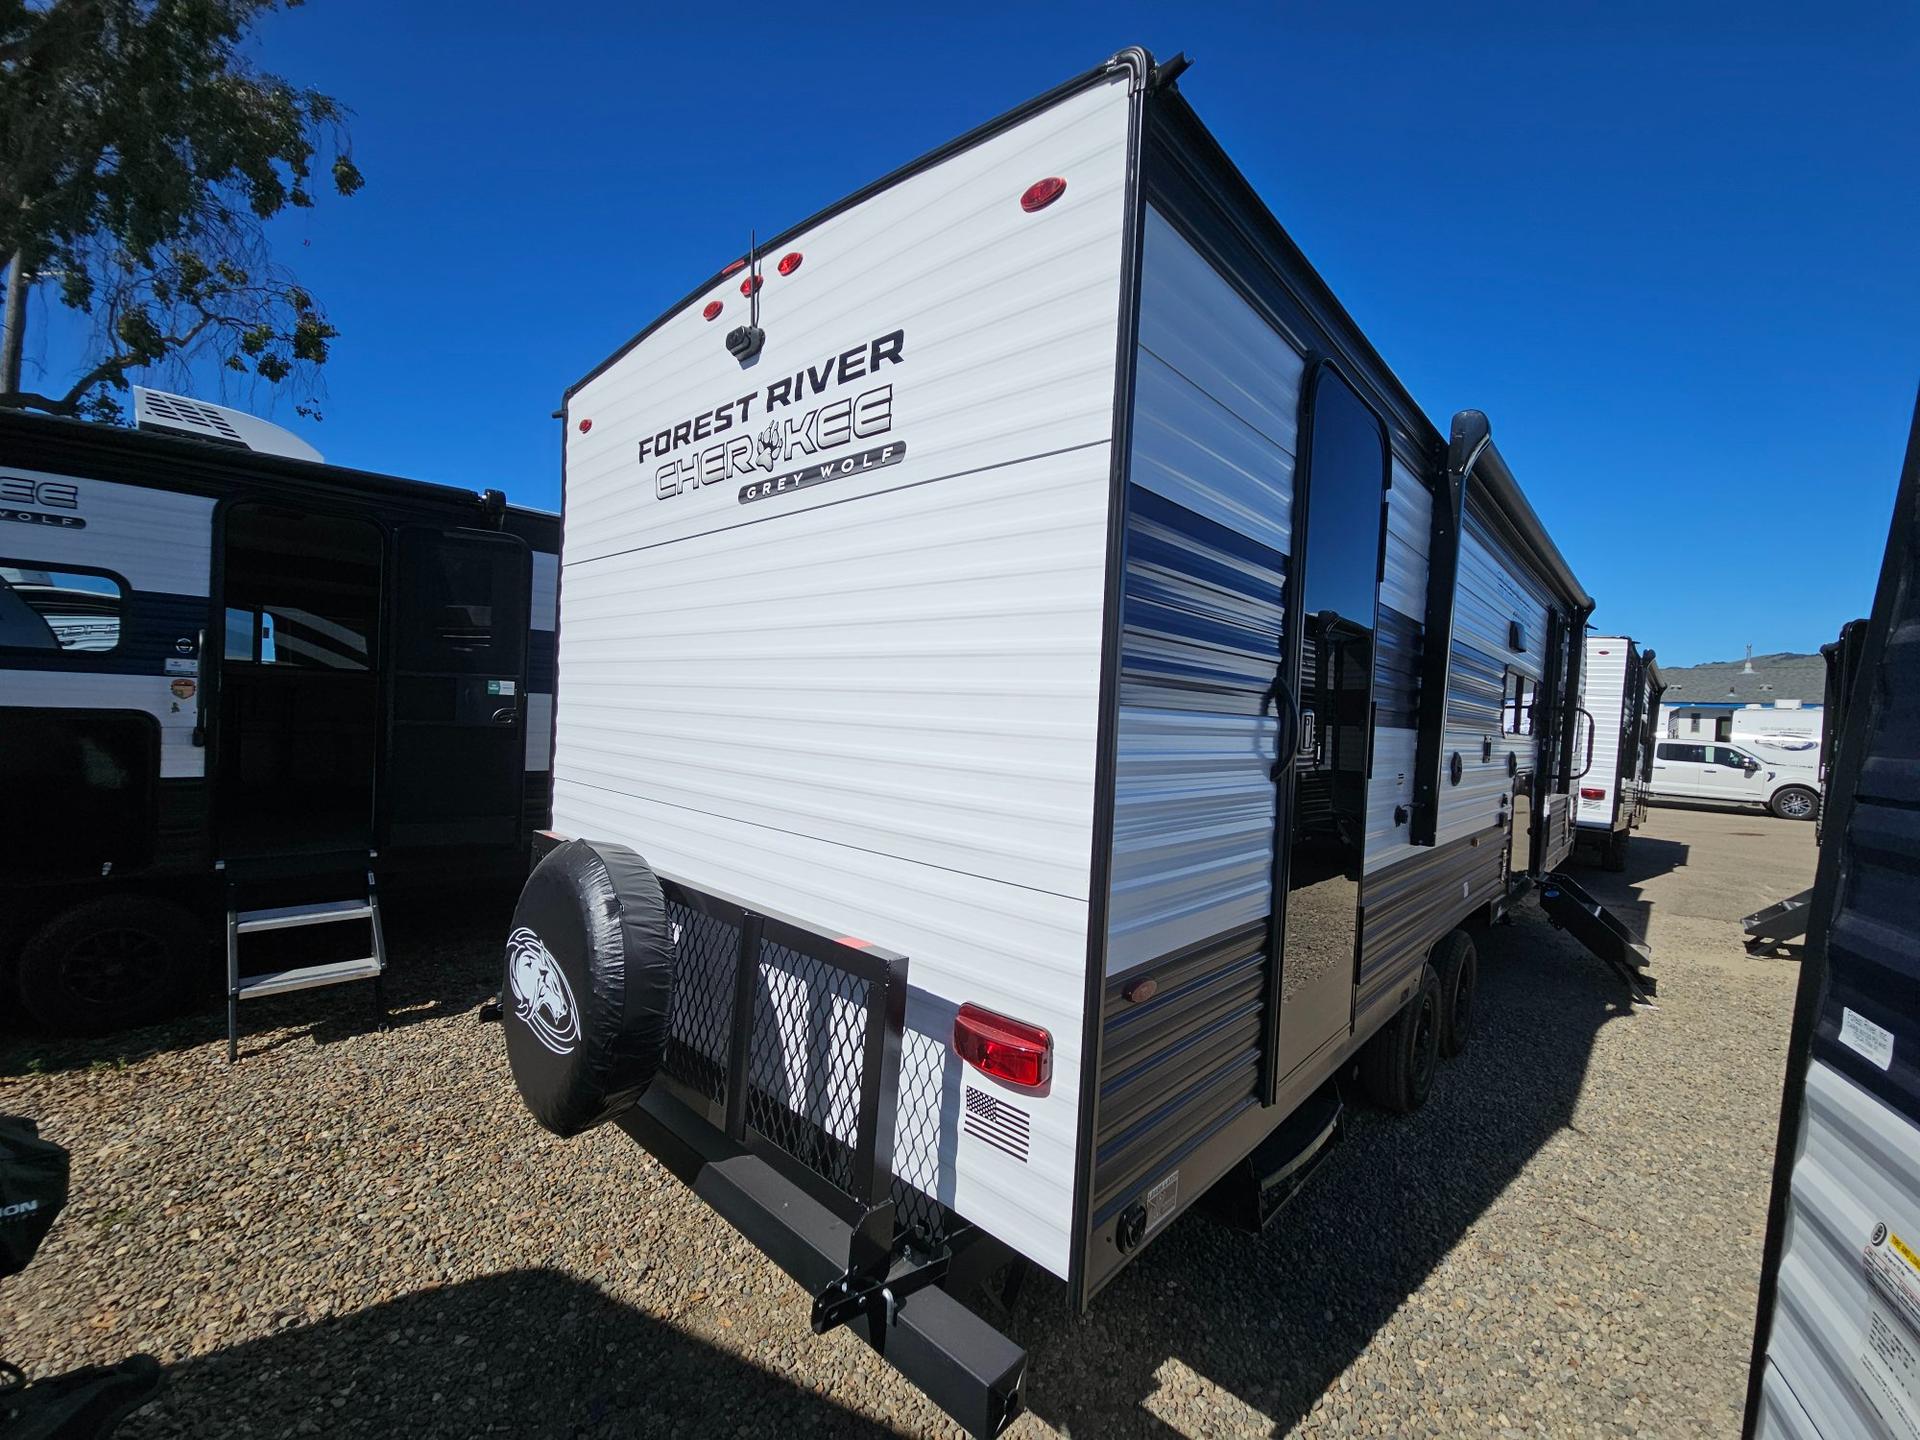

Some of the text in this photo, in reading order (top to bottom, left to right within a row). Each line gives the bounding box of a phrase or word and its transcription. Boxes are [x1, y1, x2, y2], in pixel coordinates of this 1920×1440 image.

[638, 329, 904, 464] FOREST RIVER
[746, 446, 894, 499] GREY WOLF
